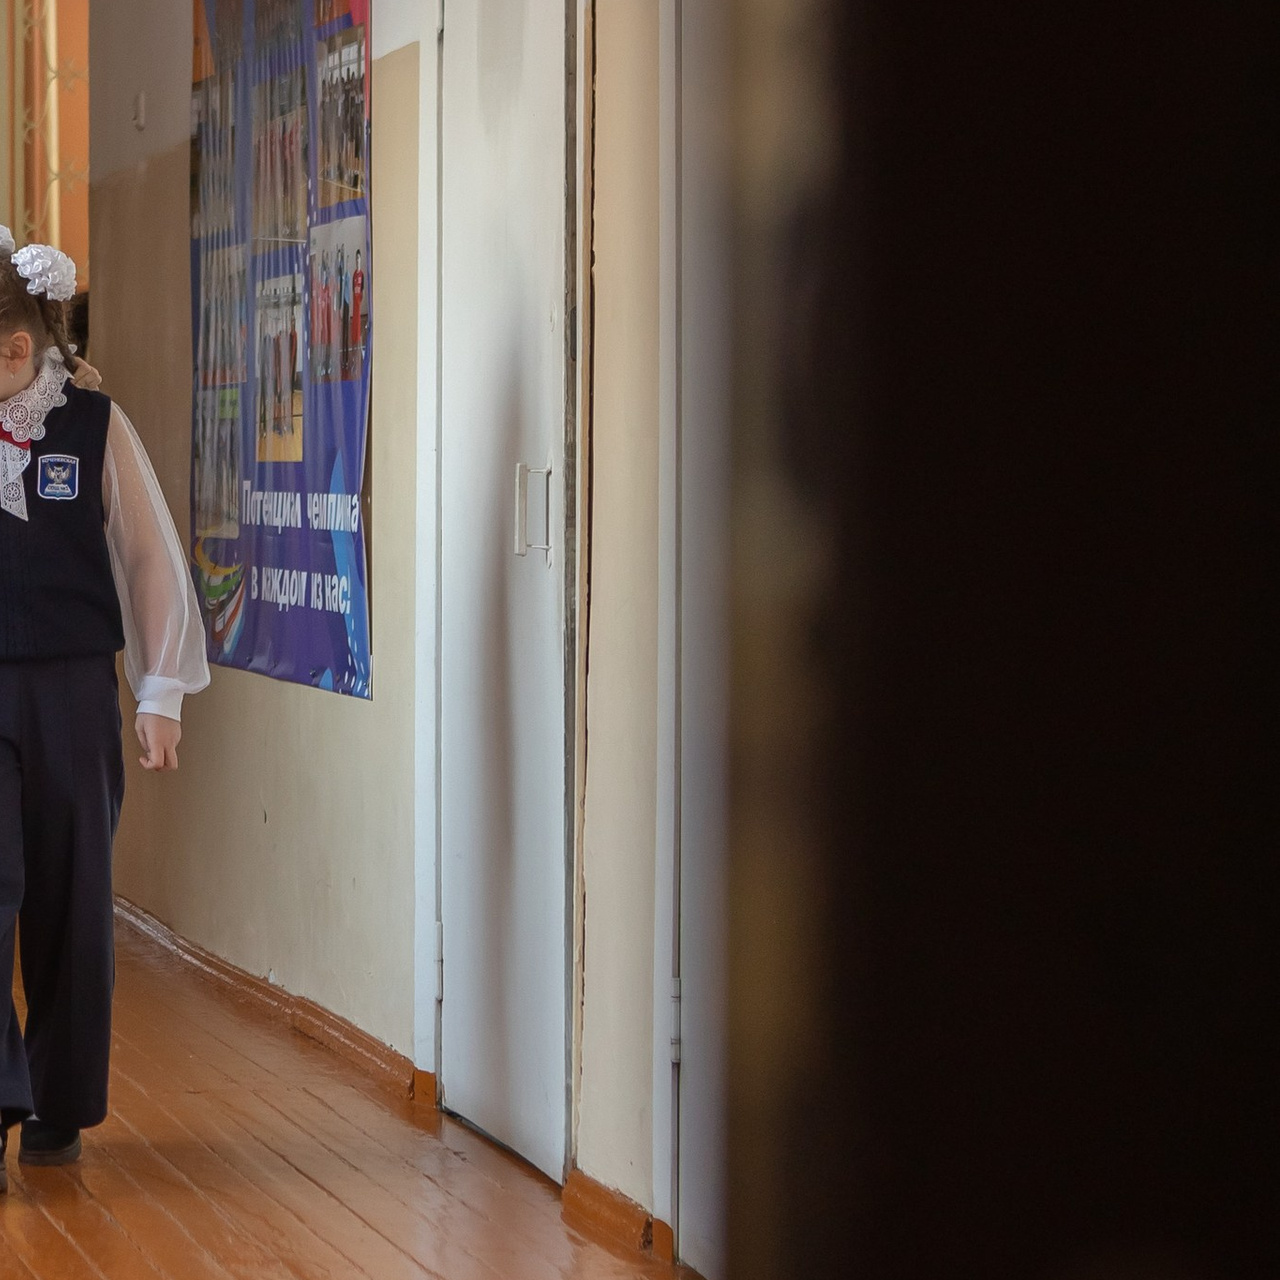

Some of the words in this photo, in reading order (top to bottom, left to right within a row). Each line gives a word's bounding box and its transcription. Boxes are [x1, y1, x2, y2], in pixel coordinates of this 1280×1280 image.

[306, 492, 360, 533] чемпина
[251, 566, 258, 600] в
[310, 572, 323, 611] из
[324, 564, 351, 614] нас!
